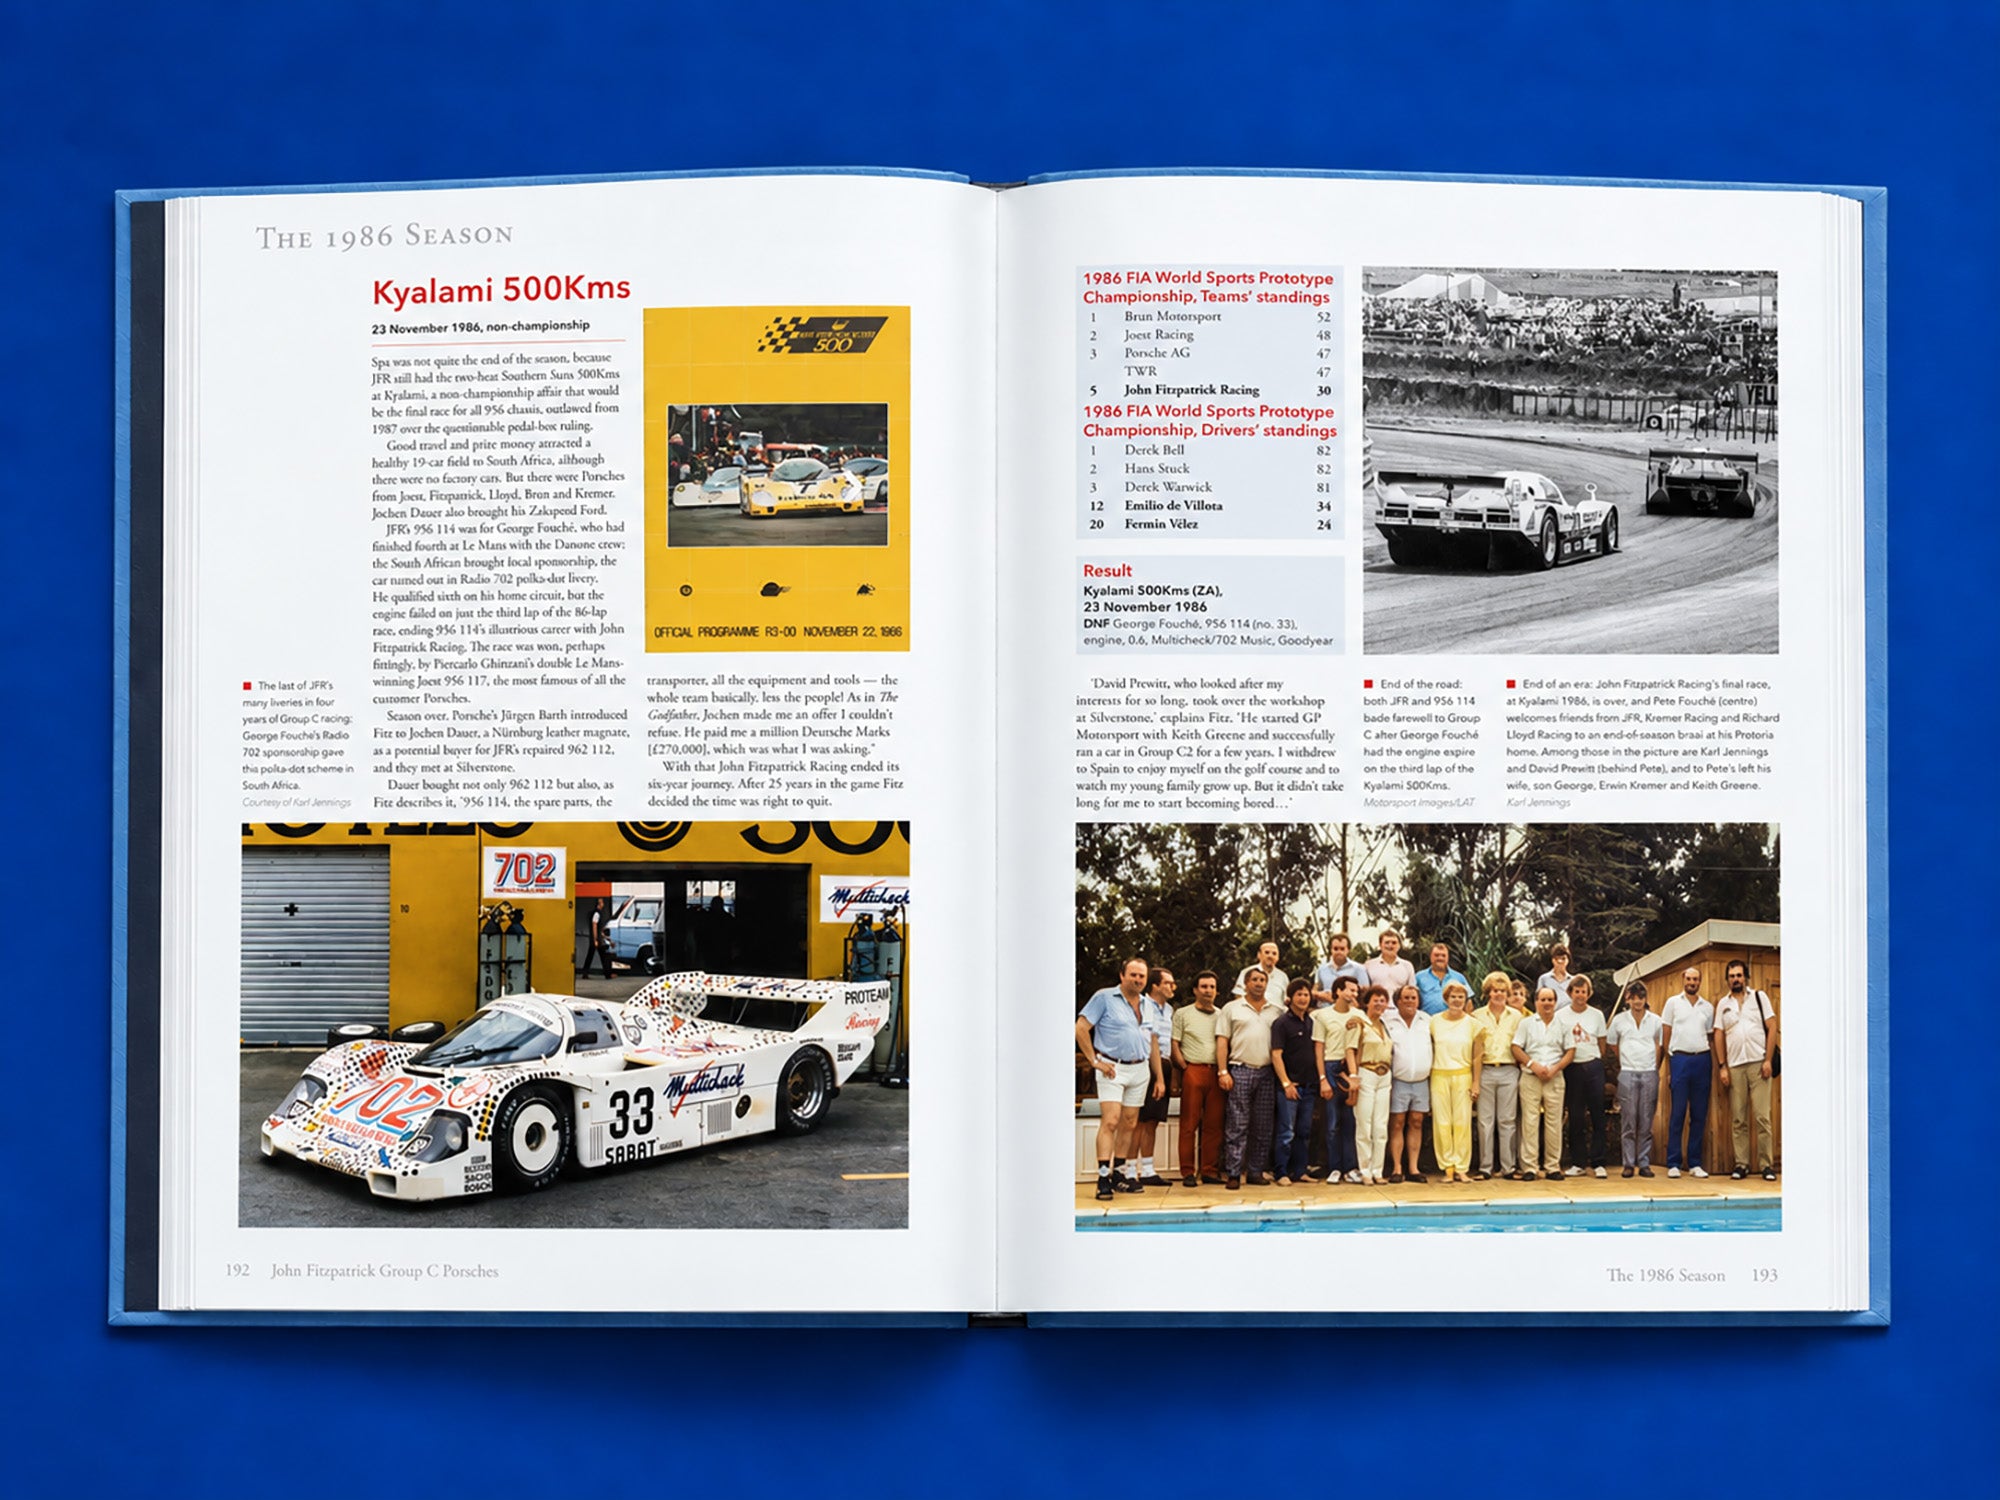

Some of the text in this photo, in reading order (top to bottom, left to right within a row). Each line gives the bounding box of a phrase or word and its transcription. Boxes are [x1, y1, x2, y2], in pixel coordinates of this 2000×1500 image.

[328, 225, 392, 252] 1986
[1084, 271, 1333, 287] 1986 FIA World Sports Prototype
[374, 275, 630, 312] Kyalami 500Kms
[1257, 291, 1330, 306] standings
[1092, 310, 1331, 324] 1 Brun Motorsport 52
[372, 324, 386, 335] 23
[390, 323, 448, 334] November
[486, 320, 590, 333] non-championship
[1090, 329, 1331, 343] 2 Joest Racing 48
[813, 337, 853, 352] 500
[1090, 347, 1331, 360] 3 Porsche AG 47
[1124, 366, 1331, 377] TWR 47
[1090, 384, 1331, 398] 5 John Fitzpatrick Racing 30
[1084, 404, 1334, 420] 1986 FIA World Sports Prototype
[1264, 423, 1337, 439] standings
[1092, 444, 1331, 456] 1 Derek Bell 82
[1090, 463, 1331, 475] 2 Hans Stuck 82
[1090, 481, 1330, 493] 3 Derek Warwick 81
[1091, 500, 1331, 512] 12 Emilio de Villota 34
[1090, 519, 1104, 529] 20
[1317, 519, 1331, 530] 24
[1084, 563, 1132, 577] Result
[1084, 585, 1133, 599] Kyalami
[1138, 585, 1189, 596] 500Kms
[1084, 601, 1207, 612] 23 November 1986
[1084, 618, 1110, 629] DNF
[1113, 618, 1155, 631] George
[1205, 619, 1227, 628] 956
[1231, 619, 1250, 628] 114
[1152, 635, 1237, 645] Multicheck/702
[1278, 635, 1333, 648] Goodyear
[258, 681, 276, 690] The
[278, 681, 294, 690] last
[297, 680, 307, 690] of
[1174, 678, 1197, 688] who
[1201, 678, 1236, 689] looked
[1239, 678, 1263, 689] after
[1267, 682, 1283, 691] my
[1381, 679, 1401, 689] End
[1404, 679, 1414, 689] of
[1417, 679, 1433, 689] the
[1523, 679, 1543, 689] End
[1545, 679, 1556, 689] of
[1596, 680, 1621, 689] John
[1623, 679, 1675, 690] Fitzpatrick
[1722, 679, 1743, 689] final
[663, 760, 899, 774] With that John Fitzpatrick Racing ended its
[648, 795, 689, 806] decided
[692, 795, 709, 806] the
[712, 796, 737, 806] time
[763, 795, 788, 809] right
[494, 852, 556, 887] 702
[845, 987, 889, 1005] PROTEAM
[609, 1087, 654, 1140] 33
[227, 1264, 499, 1281] 192 John Fitzpatrick Group C Porsches
[1606, 1268, 1778, 1282] The 1986 Season 193
